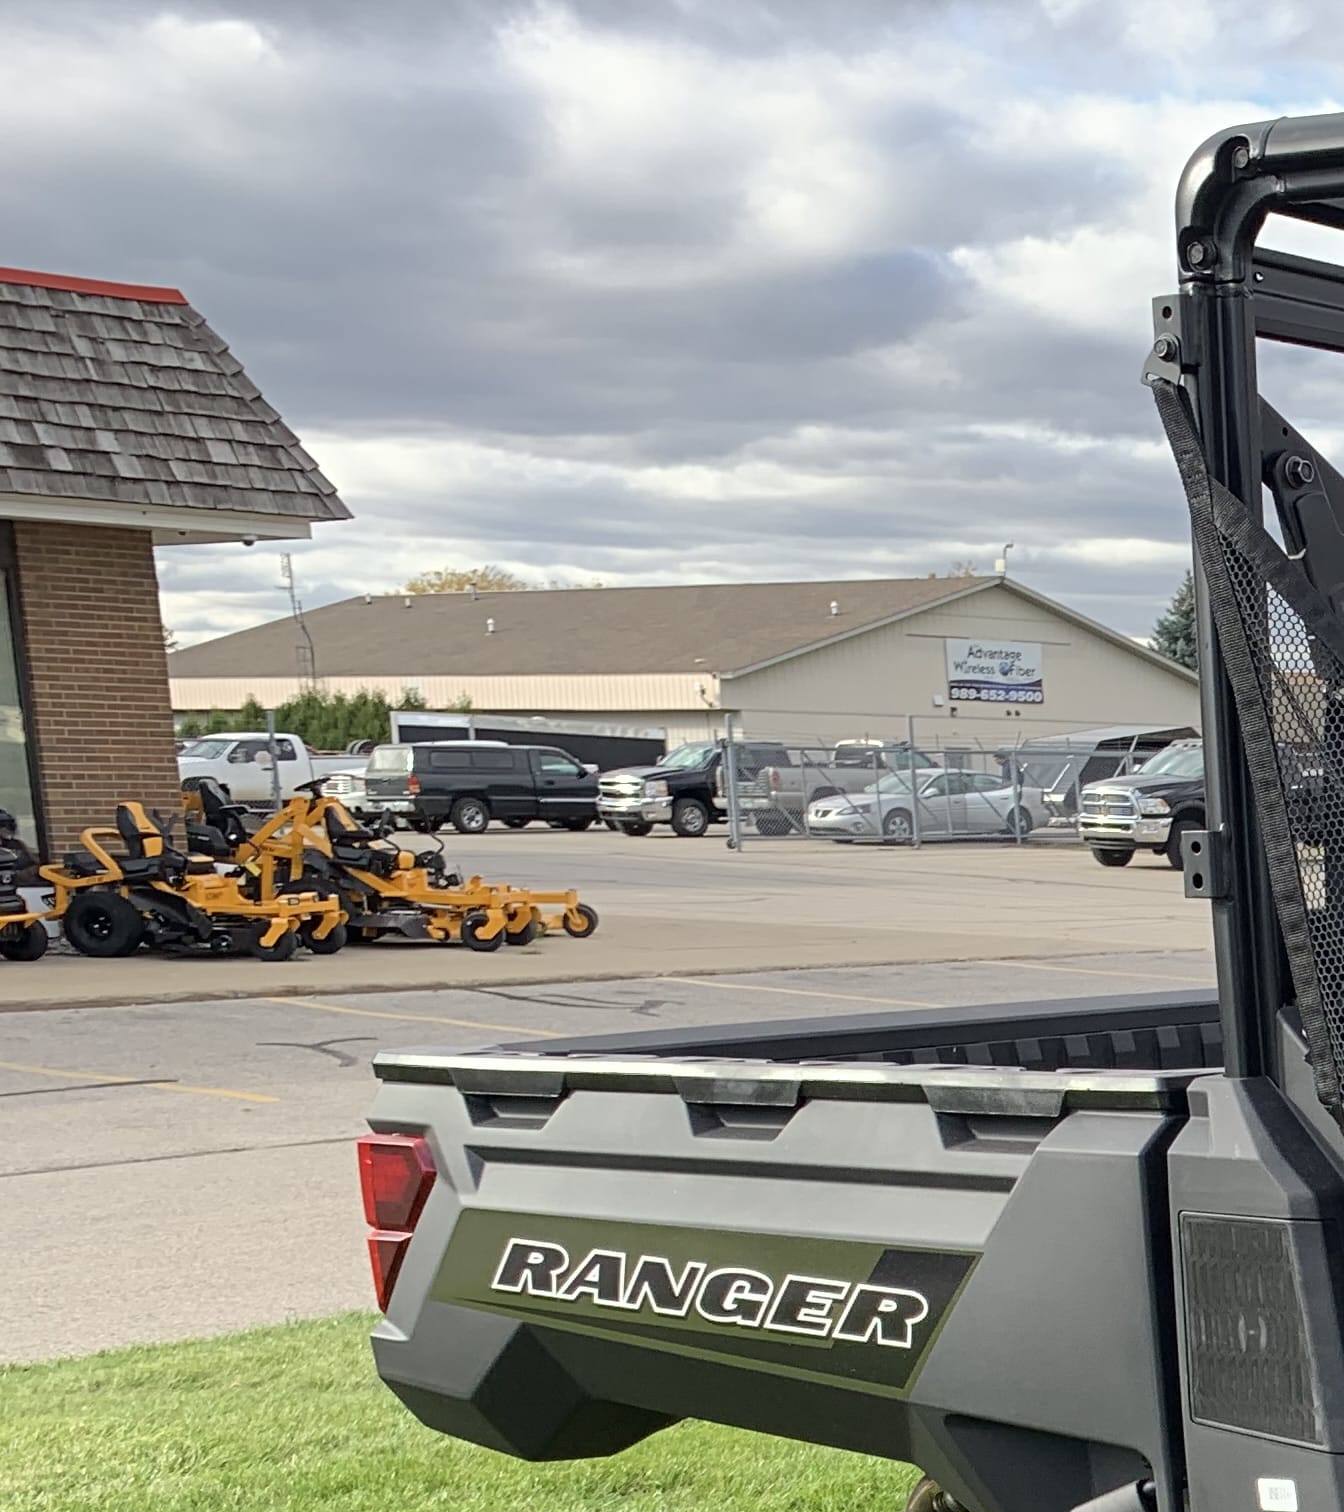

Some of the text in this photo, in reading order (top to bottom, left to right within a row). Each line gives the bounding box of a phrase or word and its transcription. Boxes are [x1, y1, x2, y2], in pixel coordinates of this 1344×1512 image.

[967, 645, 1022, 662] Advantage
[953, 660, 996, 675] Wireless
[951, 687, 1042, 702] 989-652-9500
[492, 1237, 929, 1349] RANGER
